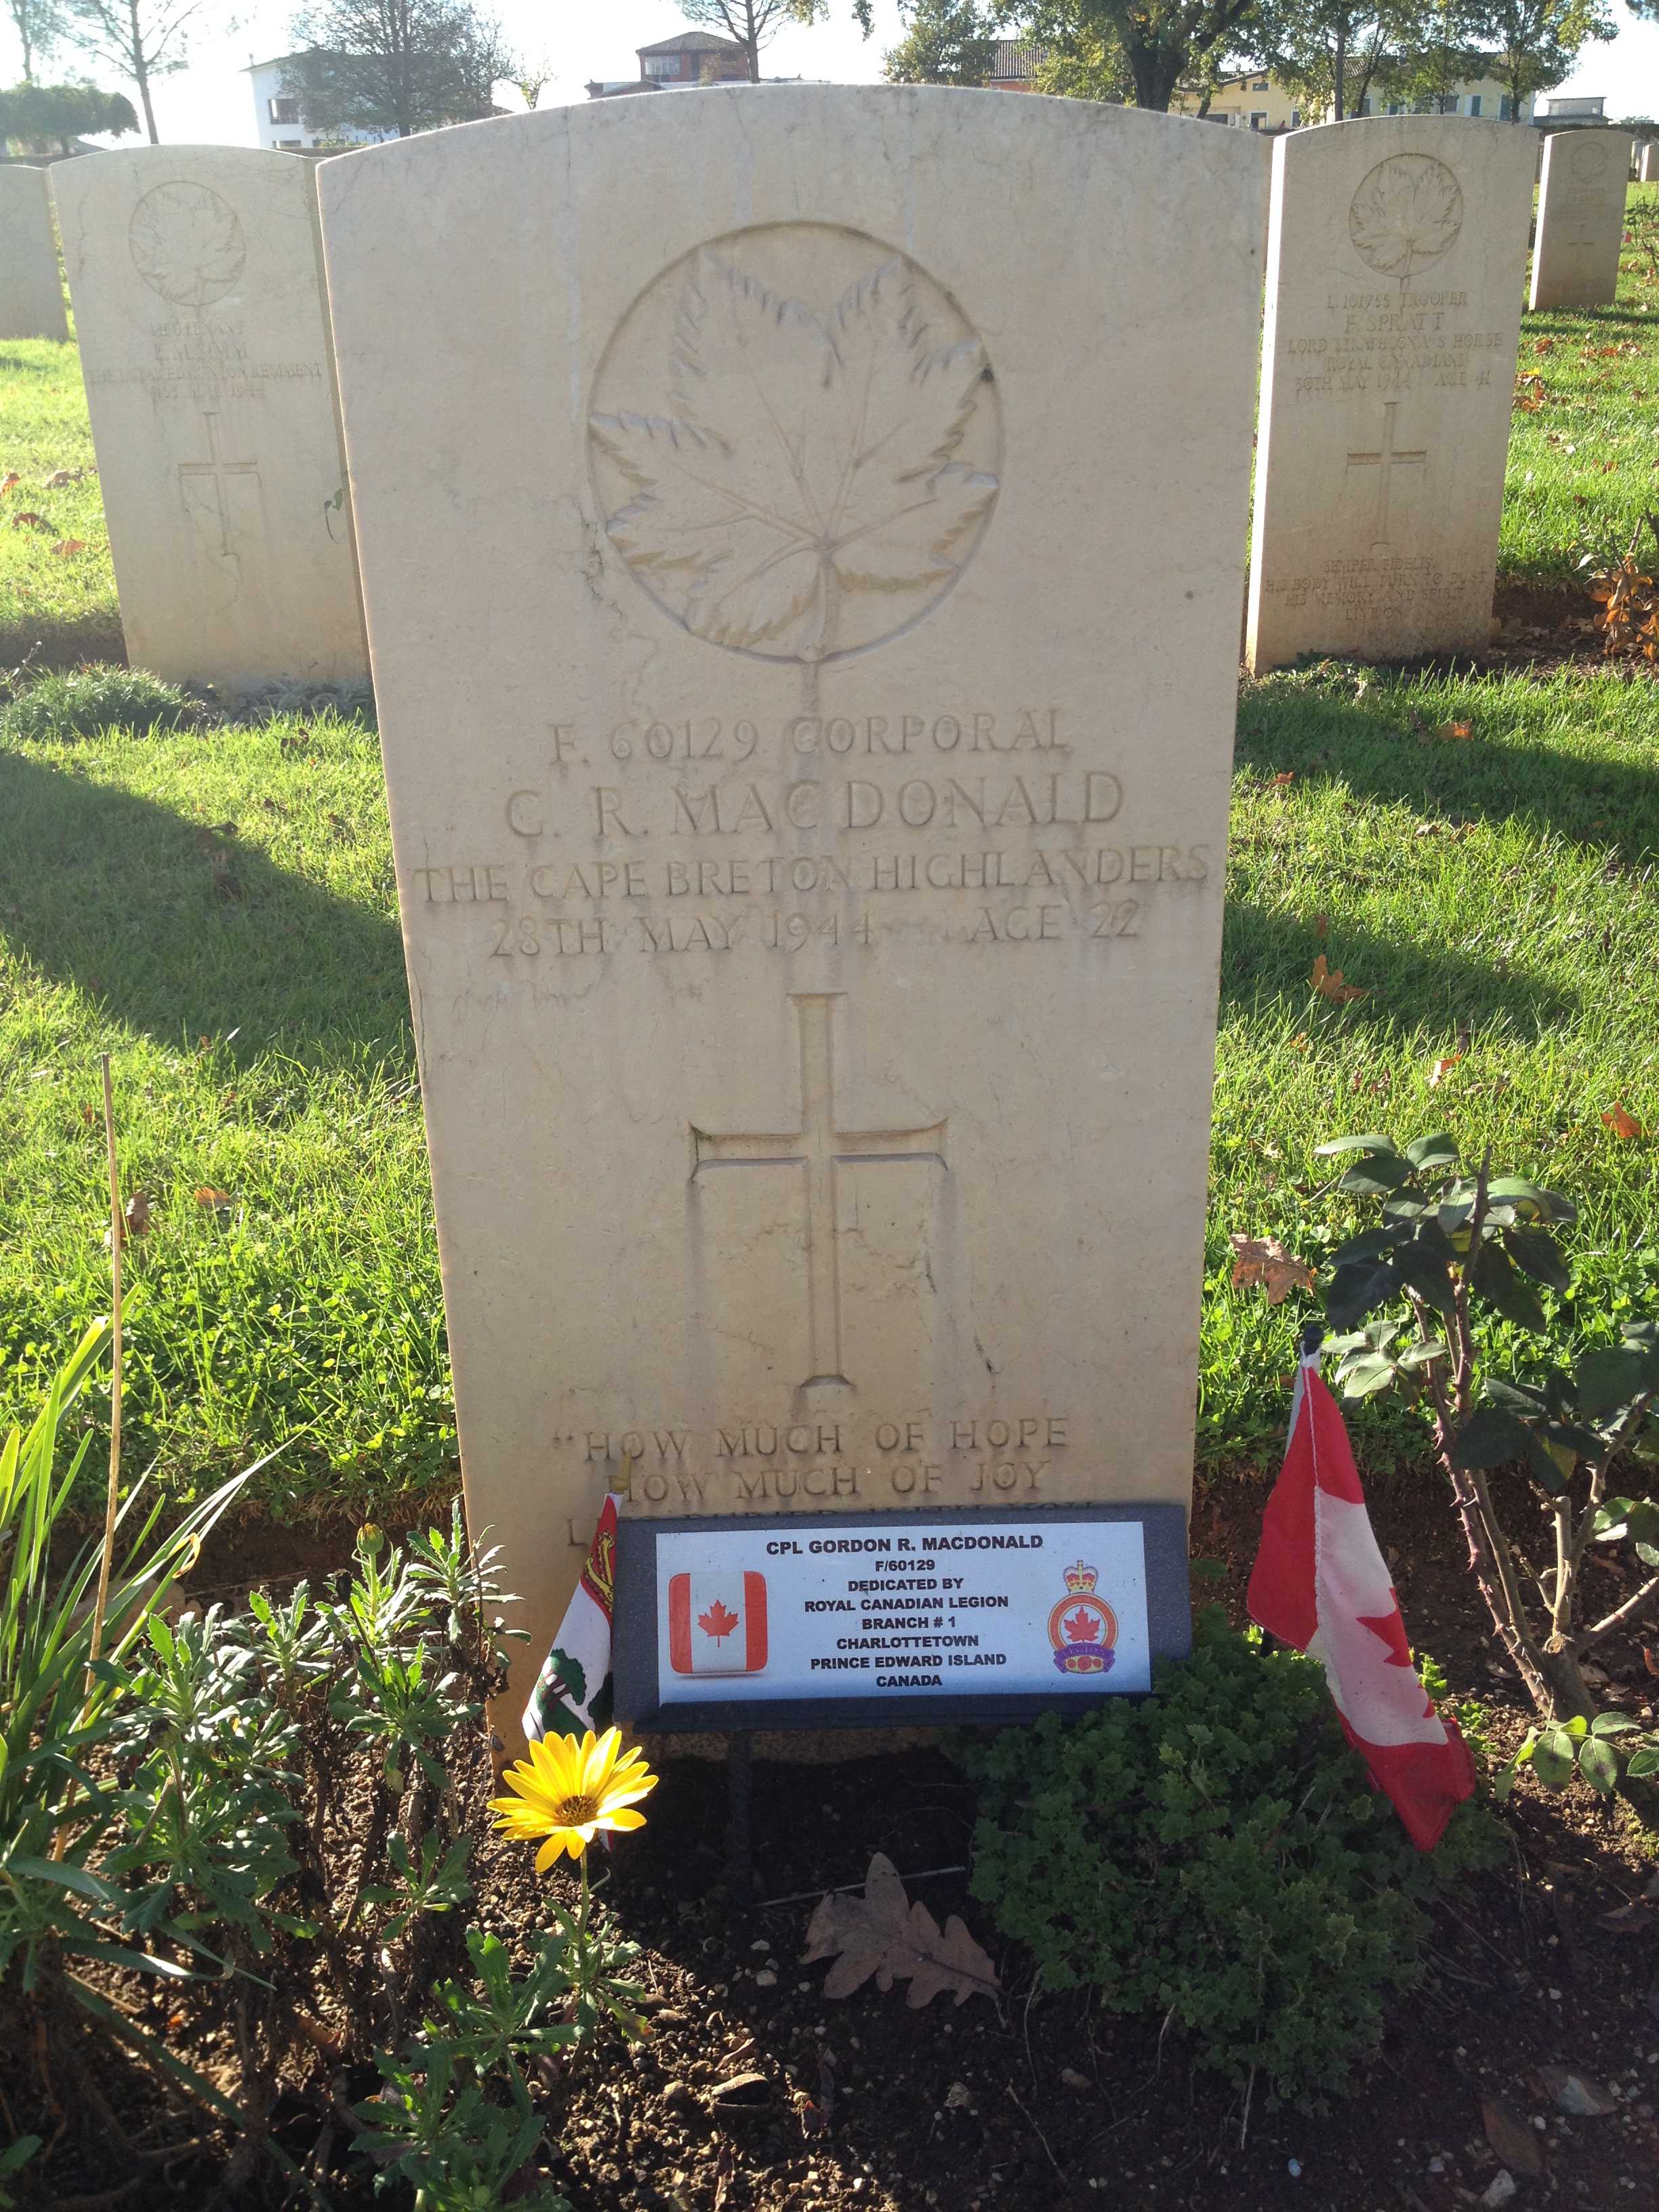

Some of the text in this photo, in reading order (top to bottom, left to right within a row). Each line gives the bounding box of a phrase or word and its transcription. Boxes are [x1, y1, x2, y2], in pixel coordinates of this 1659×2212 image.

[1367, 312, 1444, 331] SPRATT
[1288, 339, 1328, 354] LORD
[611, 716, 758, 764] 60129
[792, 708, 1073, 755] CORPORAL
[589, 785, 650, 836] R.
[413, 844, 1210, 904] THE CAPE BRETON HIGHLANDERS
[489, 898, 1140, 958] 28TH MAY 1944 AGE 22
[716, 1424, 842, 1458] MUCH
[876, 1422, 925, 1454] OF
[951, 1418, 1069, 1450] HOPE
[734, 1466, 859, 1499] MUCH
[891, 1464, 943, 1494] OF
[969, 1460, 1052, 1491] JOY
[766, 1541, 803, 1555] CPL
[808, 1538, 891, 1554] GORDON
[922, 1535, 1043, 1551] MACDONALD
[875, 1559, 935, 1572] F/60129
[848, 1578, 964, 1592] DEDICATED BY
[804, 1596, 1008, 1612] ROYAL CANADIAN LEGION
[862, 1616, 956, 1630] BRANCH # 1
[836, 1635, 979, 1650] CHARLOTTETOWN
[811, 1654, 1007, 1670] PRINCE EDWARD ISLAND
[876, 1675, 943, 1687] CANADA
